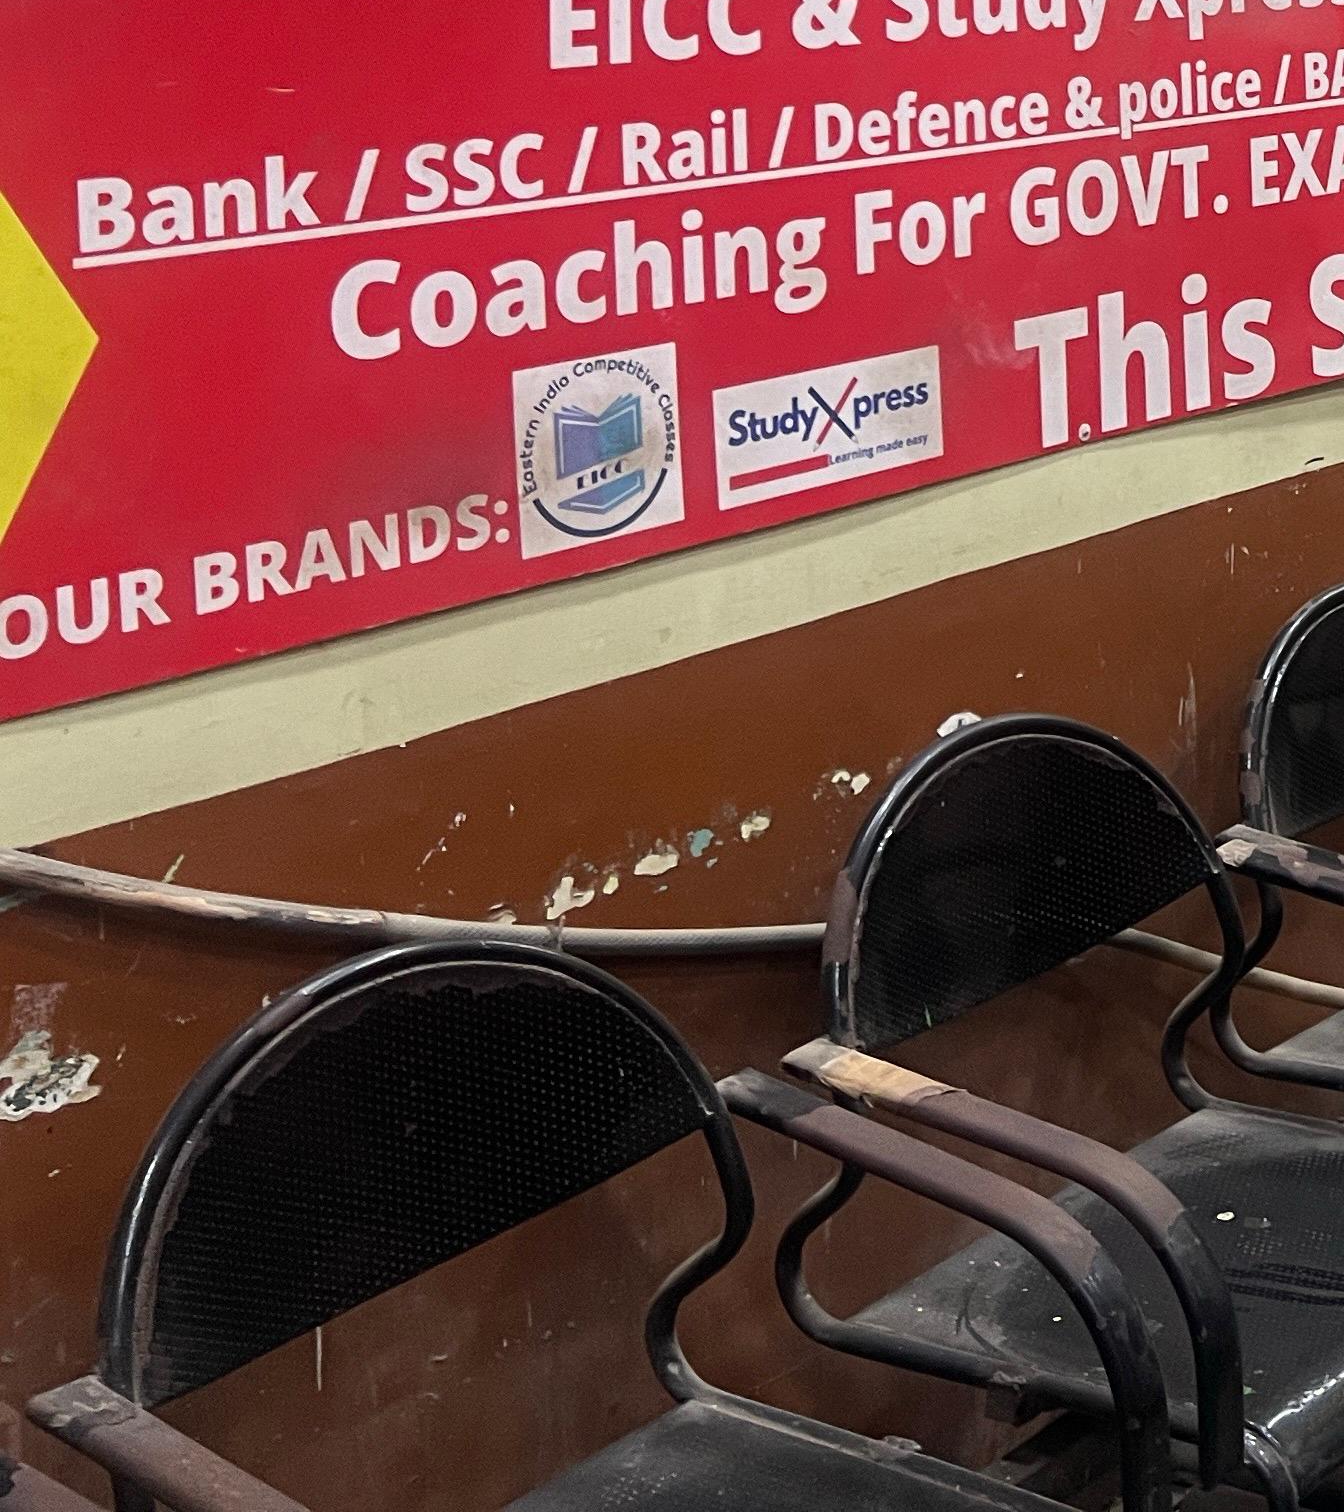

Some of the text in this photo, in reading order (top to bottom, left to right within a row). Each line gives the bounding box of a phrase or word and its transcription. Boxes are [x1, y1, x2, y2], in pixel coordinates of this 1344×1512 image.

[76, 155, 321, 254] Bank
[404, 132, 545, 214] SSC
[622, 108, 748, 185] Rail
[815, 90, 1049, 163] Defence
[1065, 76, 1104, 129] &
[1120, 60, 1261, 138] police
[330, 210, 828, 360] Coaching
[855, 189, 986, 275] For
[1010, 144, 1229, 246] GOVT.
[519, 359, 675, 497] Eastern India Competitive Classes
[1014, 273, 1276, 448] This
[829, 434, 928, 465] Learning made easy
[0, 493, 511, 660] OUR BRANDS:
